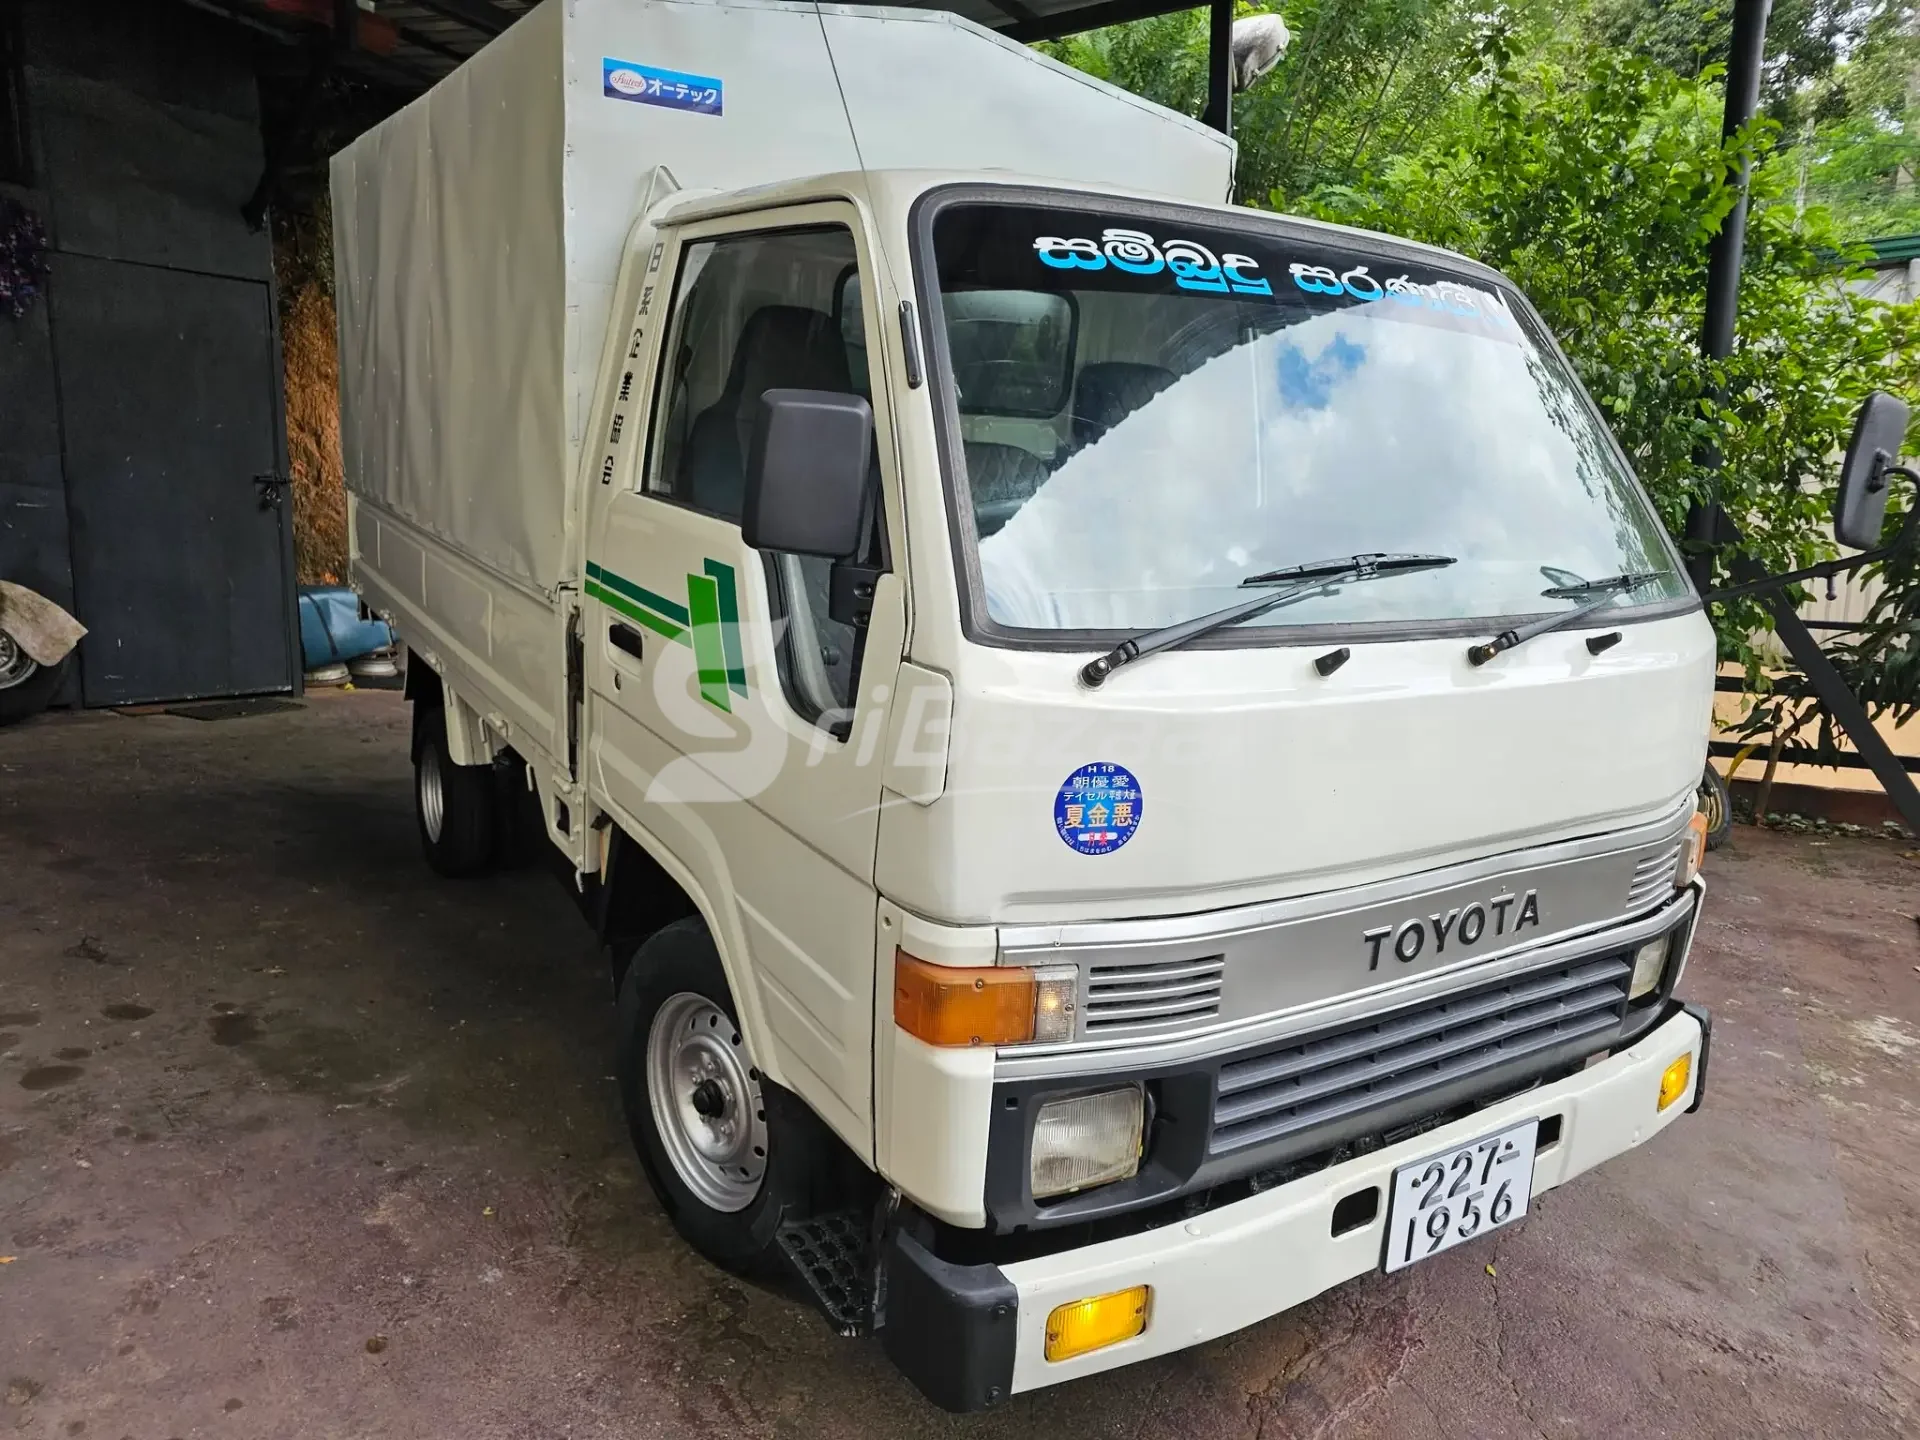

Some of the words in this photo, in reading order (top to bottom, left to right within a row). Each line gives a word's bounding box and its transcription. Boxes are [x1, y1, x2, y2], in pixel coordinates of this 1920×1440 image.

[647, 78, 717, 104] オーテック
[1033, 228, 1273, 296] සම්බුදු
[1087, 765, 1097, 773] H
[1101, 765, 1115, 773] 18
[1064, 802, 1133, 828] 夏金悪
[1363, 888, 1539, 971] TOYOTA
[1404, 1178, 1512, 1262] 1956
